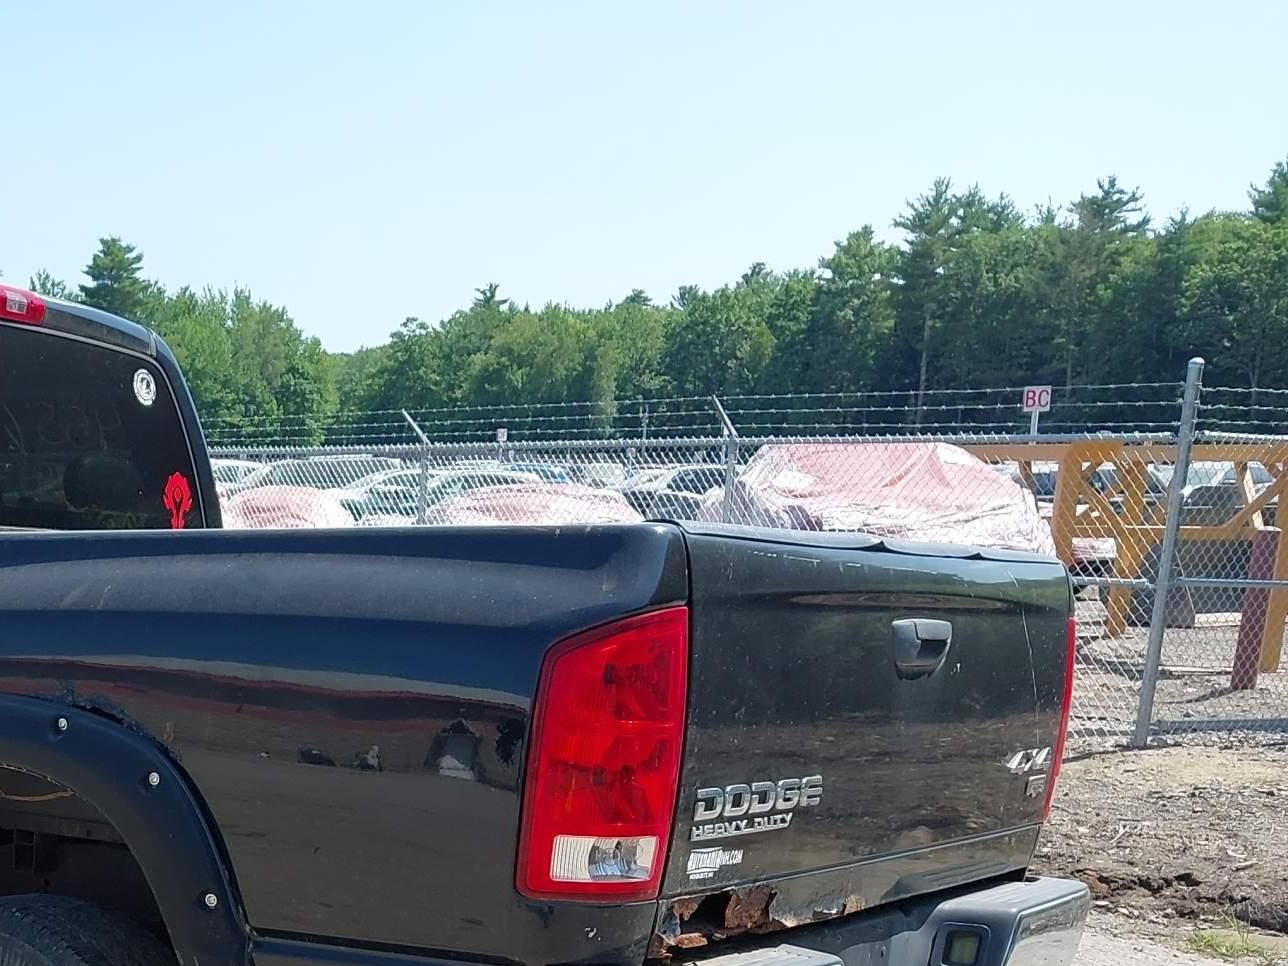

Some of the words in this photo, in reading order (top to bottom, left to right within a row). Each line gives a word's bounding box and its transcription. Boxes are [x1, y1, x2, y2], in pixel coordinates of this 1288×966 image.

[1026, 389, 1050, 408] BC
[693, 775, 823, 821] DODGE
[691, 819, 749, 841] HEAVY
[752, 811, 793, 833] DUTY
